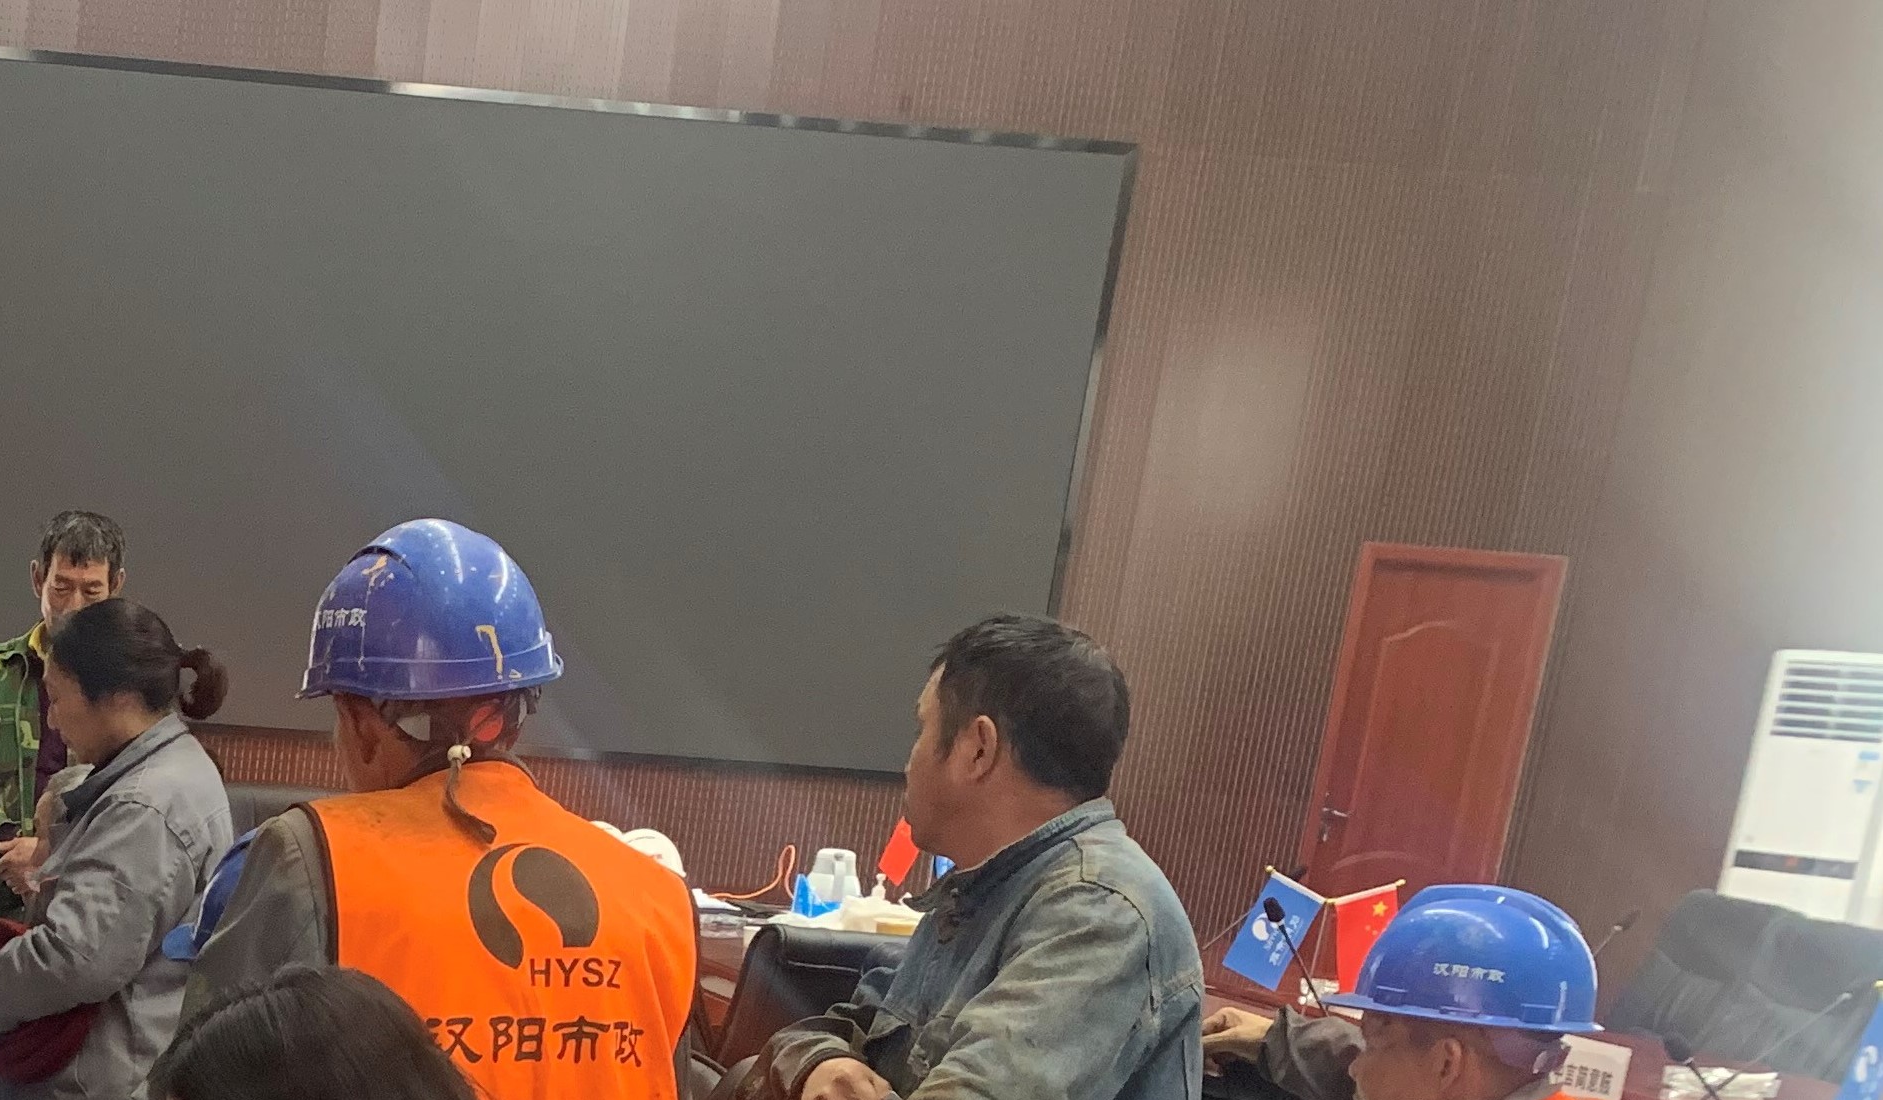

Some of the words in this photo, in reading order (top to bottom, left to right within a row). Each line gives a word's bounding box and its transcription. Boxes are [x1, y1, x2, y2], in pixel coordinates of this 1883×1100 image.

[318, 607, 368, 629] 阳市政
[529, 958, 622, 989] HYSZ
